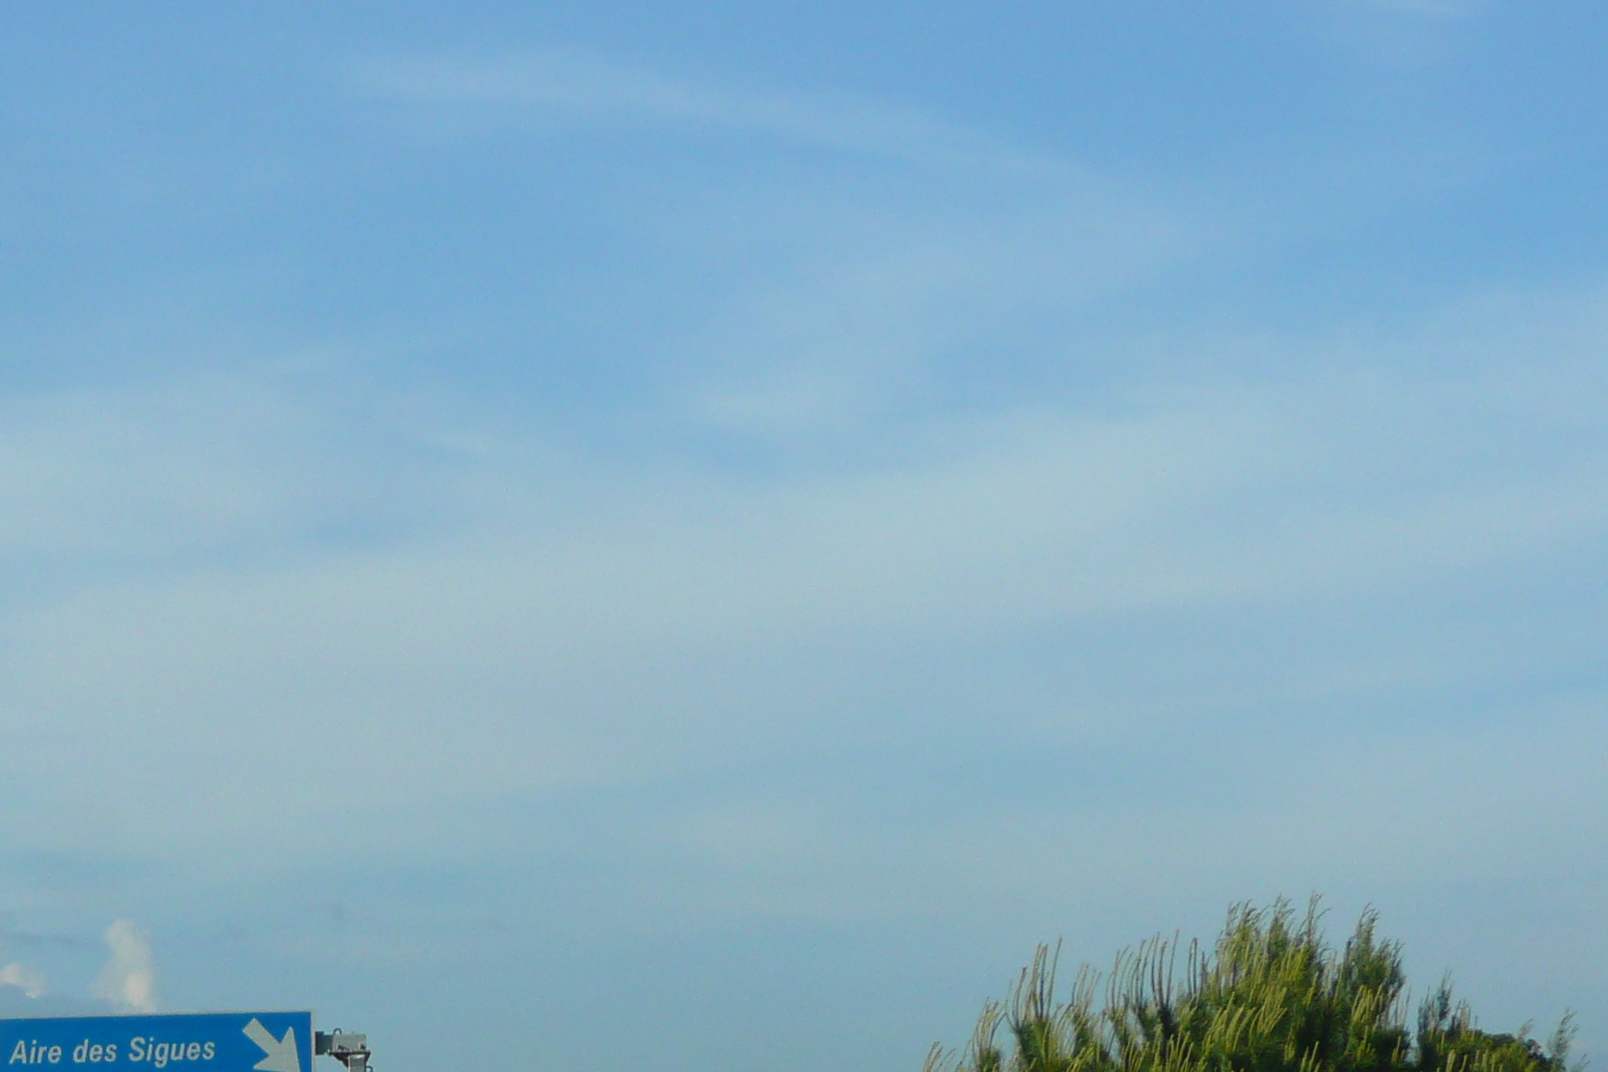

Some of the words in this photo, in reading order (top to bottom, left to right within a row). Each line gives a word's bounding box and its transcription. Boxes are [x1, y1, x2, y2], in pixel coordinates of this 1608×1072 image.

[9, 1039, 62, 1064] Aire
[73, 1039, 117, 1063] des
[128, 1036, 216, 1068] Sigues
